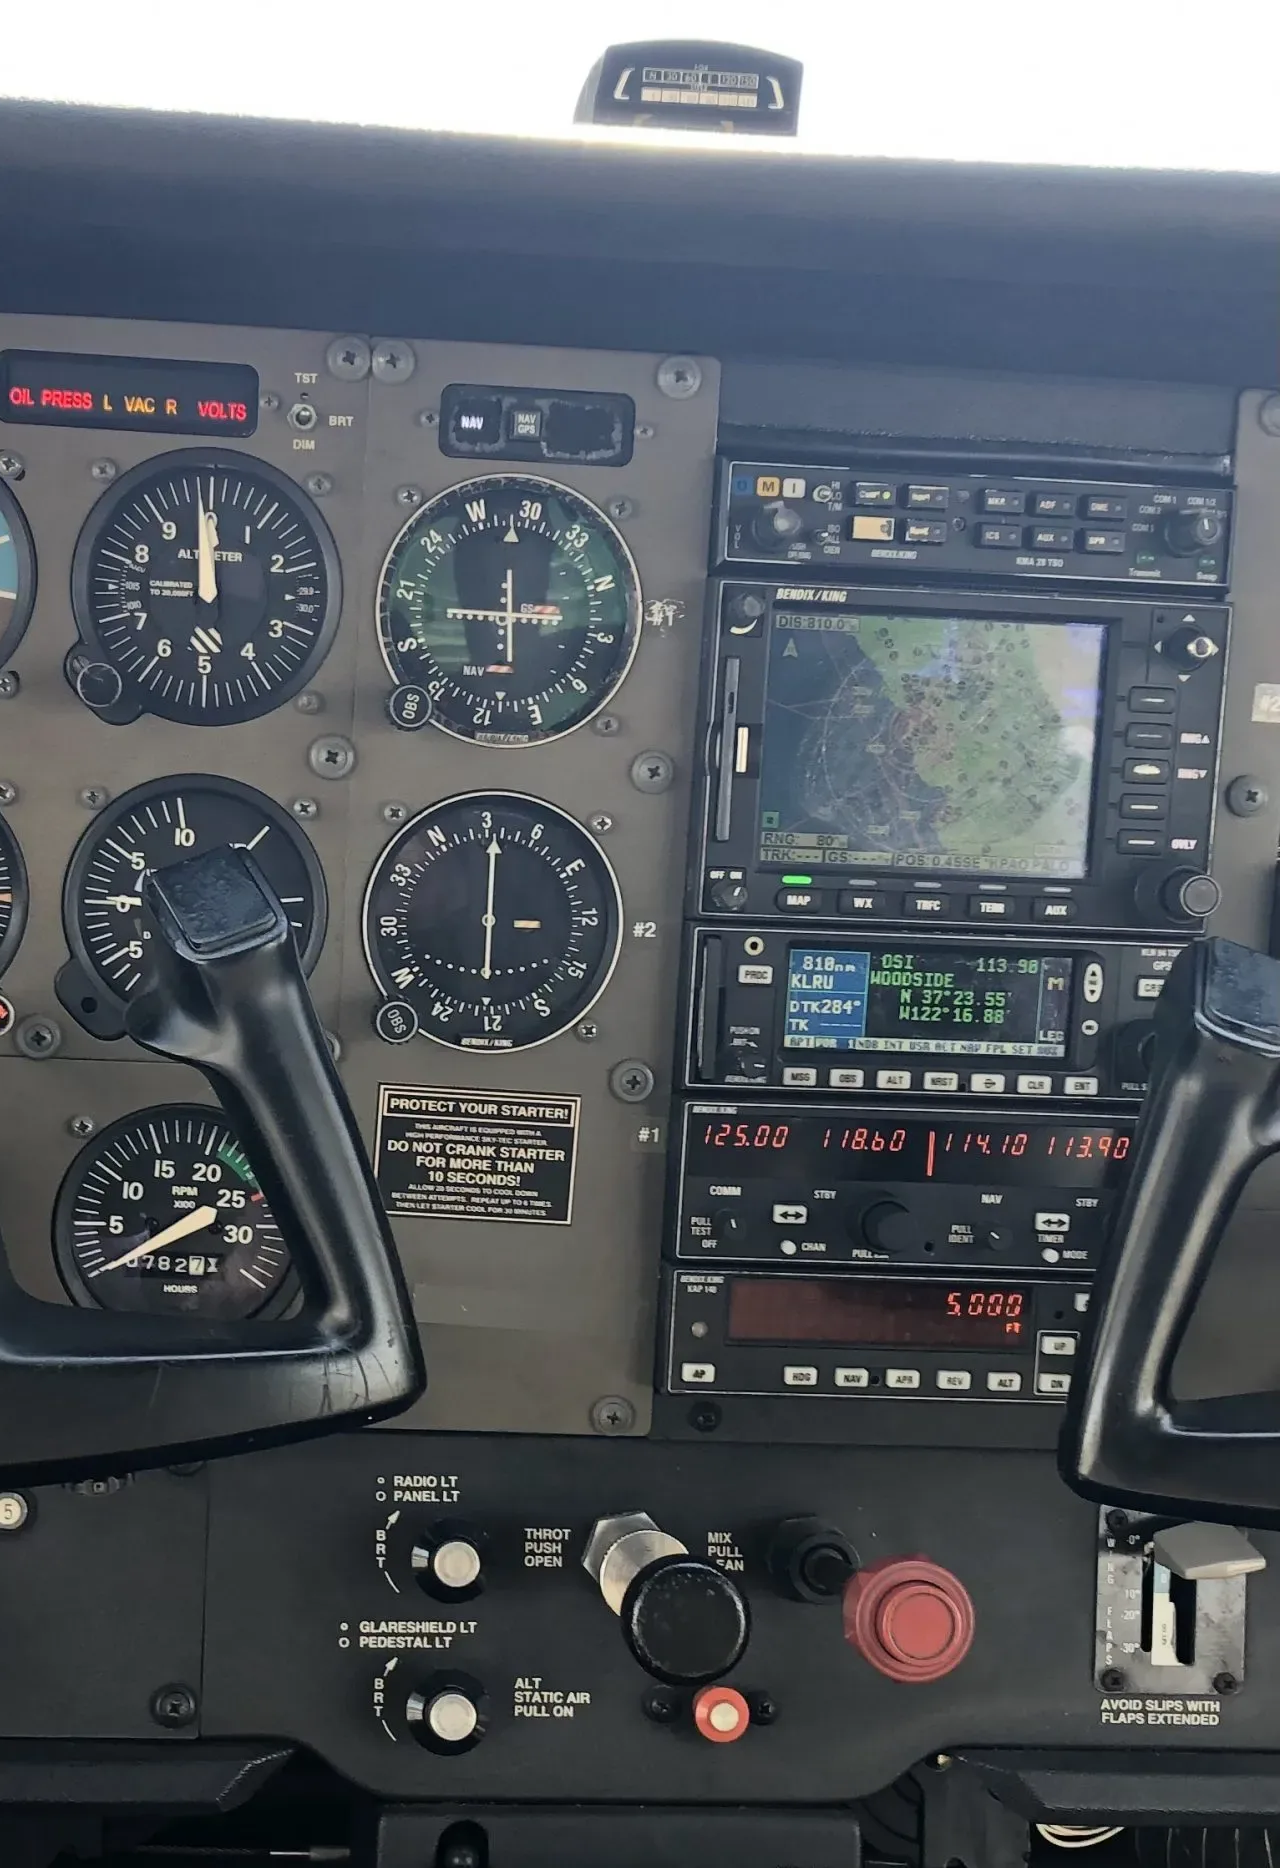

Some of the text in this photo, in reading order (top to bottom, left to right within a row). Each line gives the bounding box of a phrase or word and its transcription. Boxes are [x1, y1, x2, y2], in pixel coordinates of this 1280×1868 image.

[295, 373, 317, 383] TST
[9, 387, 247, 421] OIL PRESS L VAC R VOLTS
[329, 416, 354, 427] BRT
[460, 416, 484, 430] NAV
[518, 414, 536, 424] NAV
[518, 424, 535, 435] GPS
[293, 439, 315, 450] DIM
[786, 894, 811, 907] MAP
[632, 921, 656, 939] #2
[975, 958, 1039, 974] 113.90
[791, 973, 833, 991] KLRU
[870, 971, 955, 989] WOODSIDE
[900, 990, 911, 1005] N
[886, 1075, 903, 1086] ALT
[389, 1097, 569, 1120] PROTECT YOUR STARTER!
[638, 1127, 660, 1144] #1
[703, 1125, 790, 1149] 125.00
[945, 1132, 1027, 1156] 114.10
[1047, 1135, 1129, 1159] 113.90
[387, 1139, 565, 1161] DO NOT CRANK STARTER
[154, 1160, 175, 1180] 15
[416, 1155, 534, 1173] FOR MORE THAN
[192, 1162, 222, 1183] 20
[428, 1171, 521, 1187] 10 SECONDS!
[172, 1185, 198, 1197] RPM
[709, 1185, 741, 1197] COMM
[813, 1189, 836, 1201] STBY
[217, 1189, 246, 1209] 25
[981, 1194, 1002, 1205] NAV
[1075, 1197, 1099, 1209] STBY
[223, 1225, 253, 1244] 30
[393, 1475, 458, 1488] RADIO LT
[393, 1490, 460, 1503] PANEL LT
[524, 1528, 571, 1541] THROT
[707, 1532, 732, 1544] MIX
[524, 1542, 562, 1555] PUSH
[707, 1545, 743, 1558] PULL
[524, 1556, 563, 1568] OPEN
[359, 1621, 477, 1634] GLARESHIELD LT
[359, 1636, 453, 1649] PEDESTAL LT
[515, 1677, 542, 1689] ALT
[514, 1691, 591, 1705] STATIC AIR
[514, 1705, 574, 1718] PULL ON
[1100, 1699, 1220, 1713] AVOID SLIPS WITH
[1101, 1712, 1219, 1727] FLAPS EXTENDED
